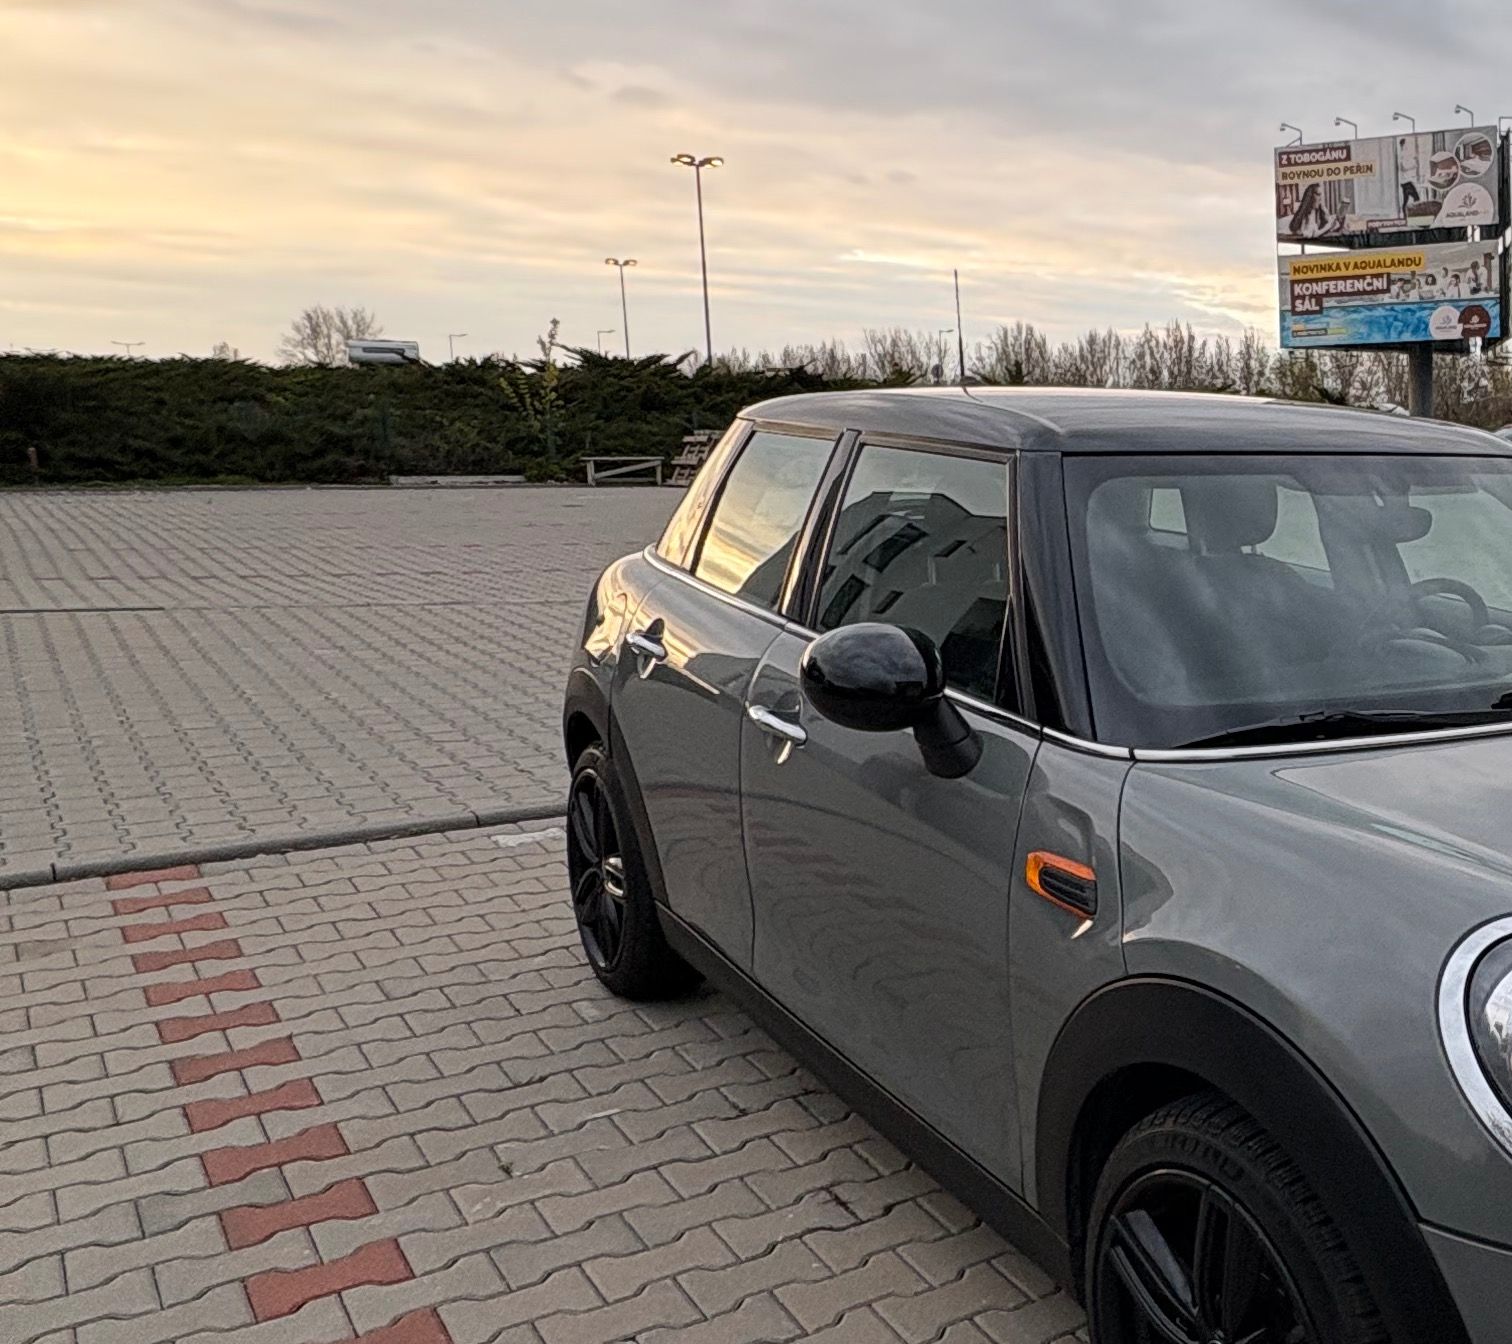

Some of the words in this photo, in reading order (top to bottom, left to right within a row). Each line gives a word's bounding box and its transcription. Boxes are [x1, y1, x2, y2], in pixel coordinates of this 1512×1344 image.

[1281, 154, 1288, 165] Z
[1289, 148, 1347, 164] TOBOGÁNU
[1281, 168, 1324, 181] ROVNOU
[1326, 166, 1341, 177] DO
[1343, 163, 1373, 176] PEŘIN
[1293, 261, 1341, 276] NOVINKA
[1342, 261, 1352, 271] V
[1352, 256, 1422, 271] AQUALANDU
[1294, 273, 1388, 296] KONFERENČNÍ
[1295, 296, 1320, 312] SÁL
